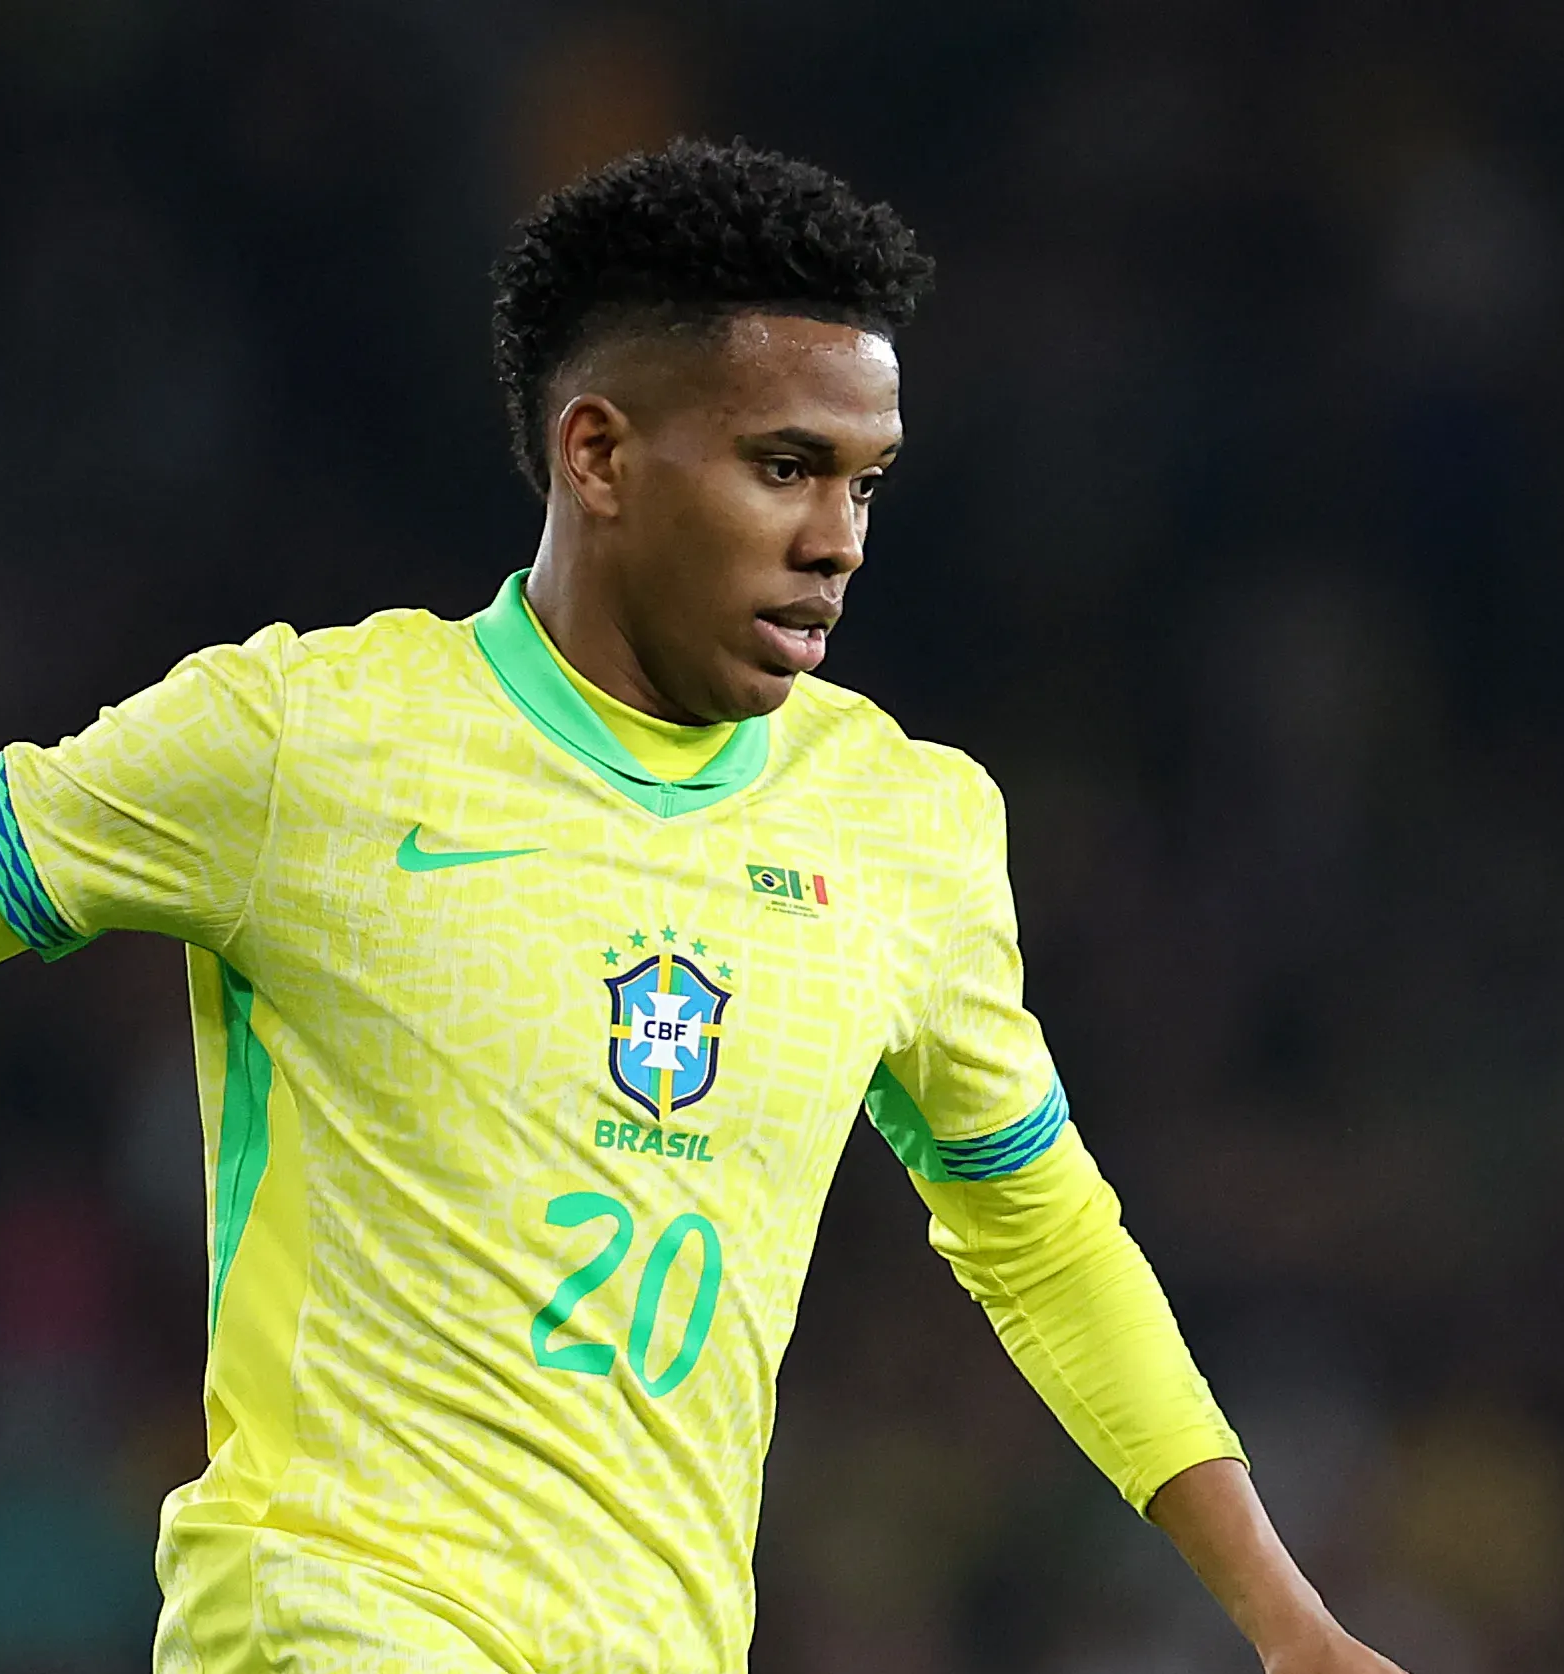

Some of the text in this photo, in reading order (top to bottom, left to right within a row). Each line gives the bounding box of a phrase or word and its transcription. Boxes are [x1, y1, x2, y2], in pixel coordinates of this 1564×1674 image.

[644, 1020, 688, 1042] CBF
[594, 1119, 714, 1162] BRASIL
[530, 1191, 722, 1398] 20
